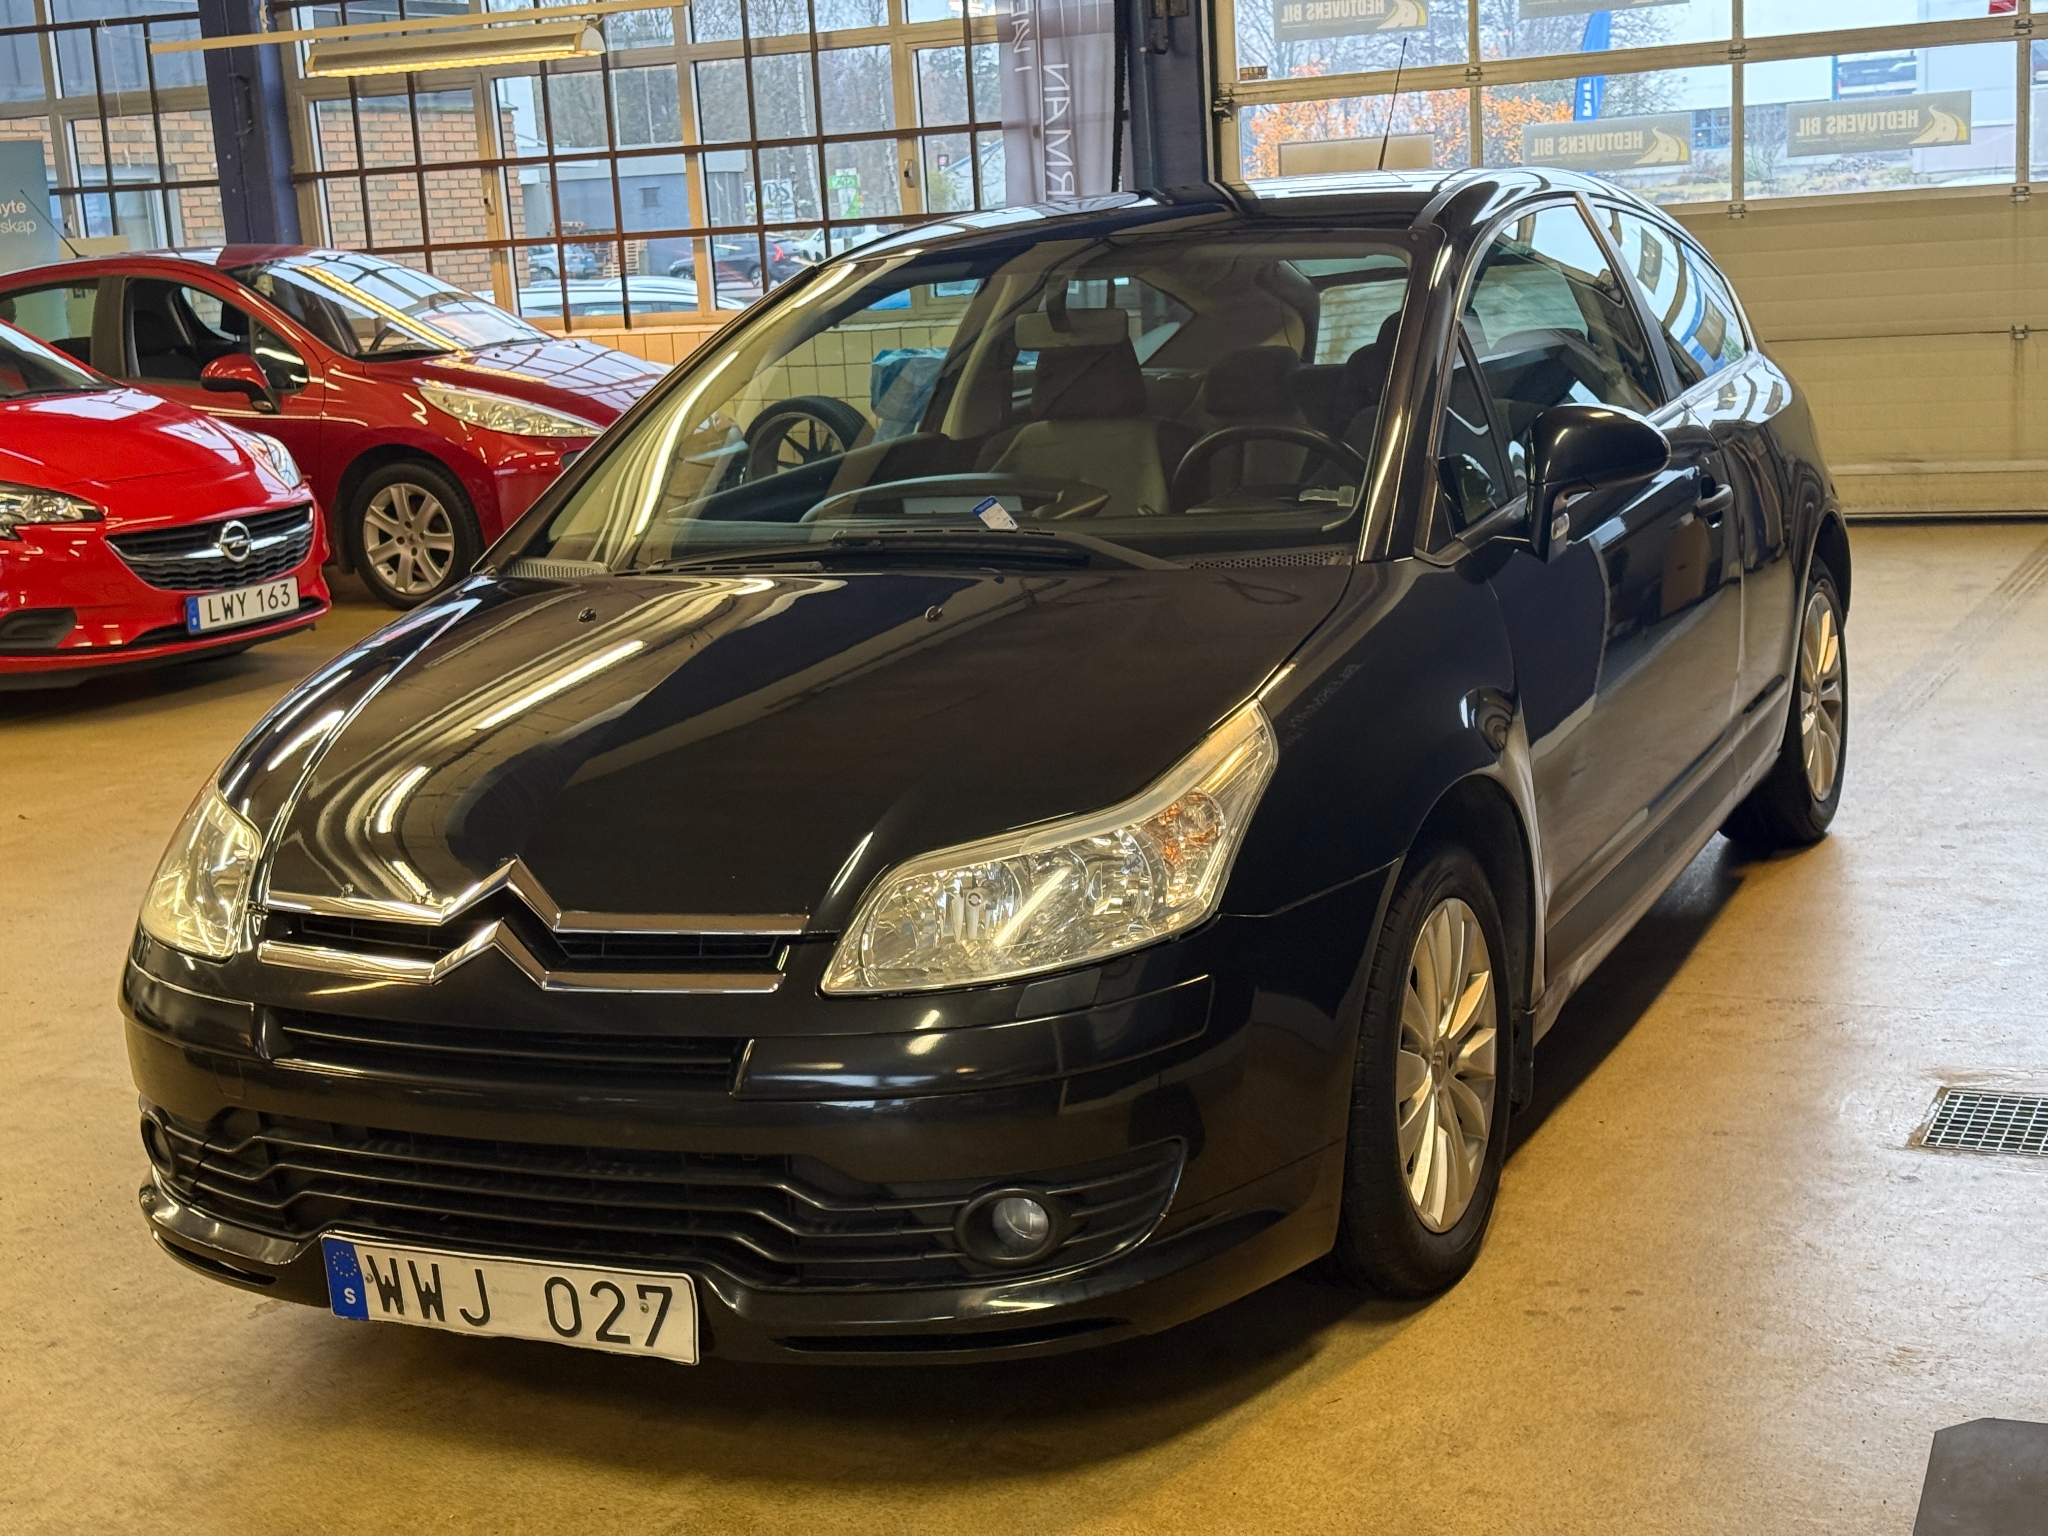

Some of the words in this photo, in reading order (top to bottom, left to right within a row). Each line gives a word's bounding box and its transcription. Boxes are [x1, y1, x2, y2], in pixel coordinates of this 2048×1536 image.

[0, 199, 27, 218] yte
[207, 592, 247, 623] LWY
[256, 583, 291, 612] 163
[344, 1287, 357, 1305] S
[366, 1254, 492, 1327] WWJ
[543, 1276, 674, 1348] 027
